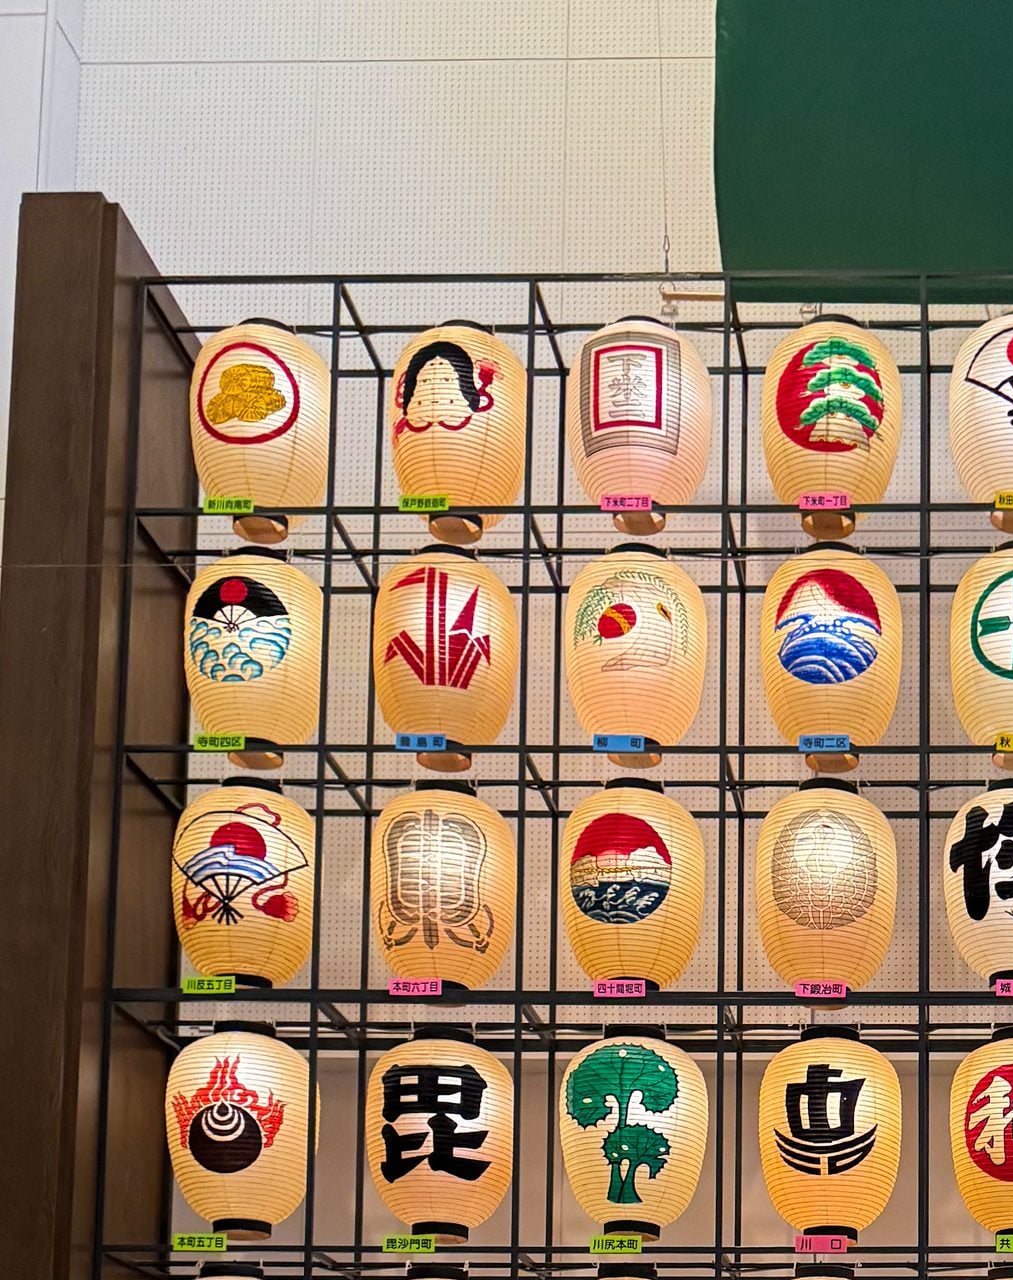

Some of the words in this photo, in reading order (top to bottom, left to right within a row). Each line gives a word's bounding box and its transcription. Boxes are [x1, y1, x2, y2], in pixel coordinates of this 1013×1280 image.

[605, 497, 649, 507] 下米町二丁目
[803, 496, 847, 506] 下米町一丁目
[197, 736, 242, 747] 寺町四区
[802, 738, 847, 748] 寺町二区
[187, 979, 232, 990] 川反五丁目
[393, 981, 438, 992] 本町六丁目
[382, 1064, 492, 1183] 毘
[177, 1237, 223, 1248] 本町五丁目
[386, 1238, 432, 1249] 毘沙門町
[593, 1239, 638, 1250] 川尻本町
[800, 1239, 841, 1250] 川口
